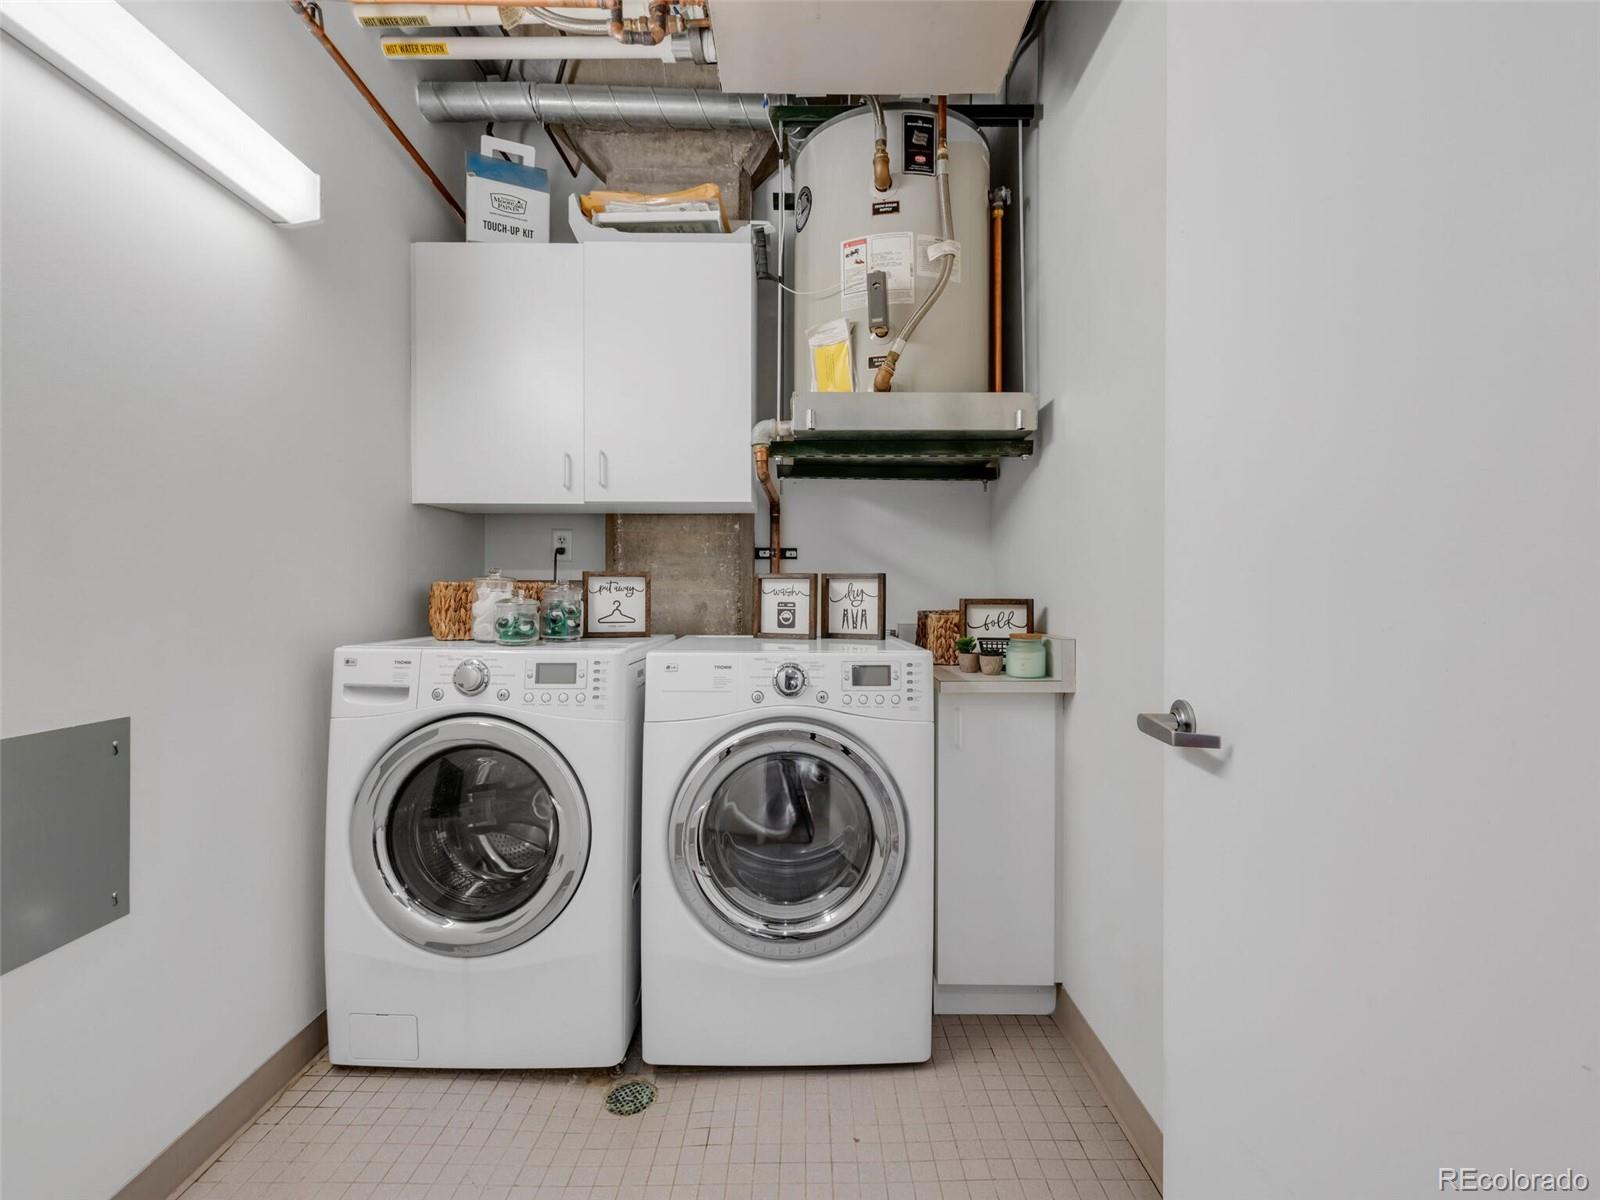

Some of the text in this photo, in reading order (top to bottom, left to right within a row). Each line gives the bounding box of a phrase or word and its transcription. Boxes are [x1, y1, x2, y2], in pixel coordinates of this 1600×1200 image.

[362, 16, 425, 26] HOT WATER SUPPLY
[385, 43, 445, 54] HOT WATER RETURN
[483, 220, 534, 239] TOUCH-UP KIT
[761, 584, 809, 597] wash
[830, 583, 878, 607] dry
[968, 611, 1027, 631] fold
